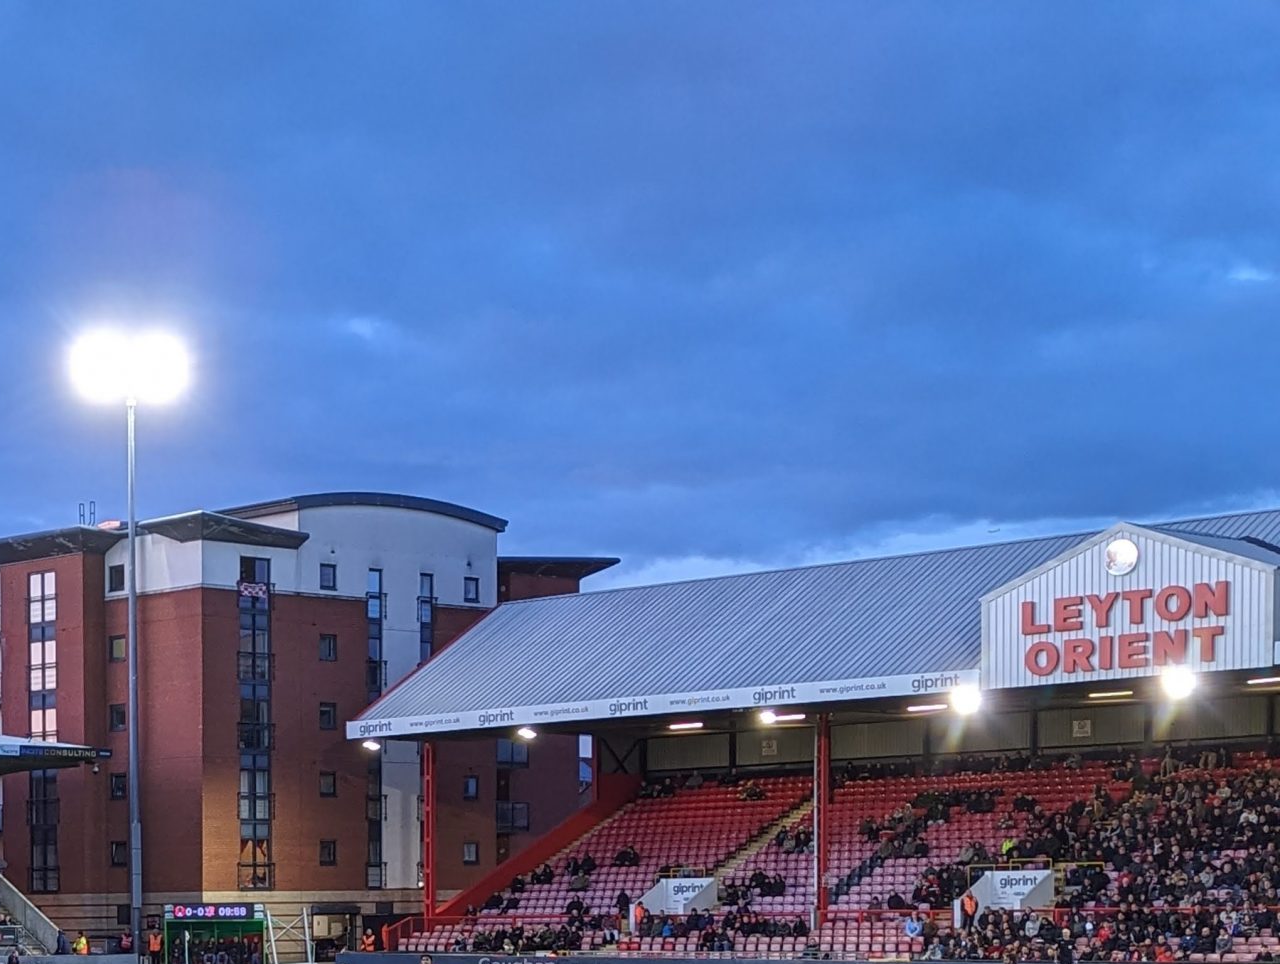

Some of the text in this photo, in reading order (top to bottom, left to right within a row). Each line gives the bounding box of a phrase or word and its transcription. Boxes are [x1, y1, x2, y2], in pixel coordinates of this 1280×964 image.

[1022, 580, 1231, 635] LEYTON
[1024, 625, 1224, 677] ORIENT
[819, 681, 887, 695] www.giprint.co.uk
[911, 674, 961, 693] giprint
[752, 686, 797, 705] giprint
[609, 699, 648, 716] giprint
[478, 710, 514, 727] giprint
[358, 720, 392, 738] giprint
[44, 749, 96, 759] CONSULTING
[1000, 875, 1037, 889] giprint
